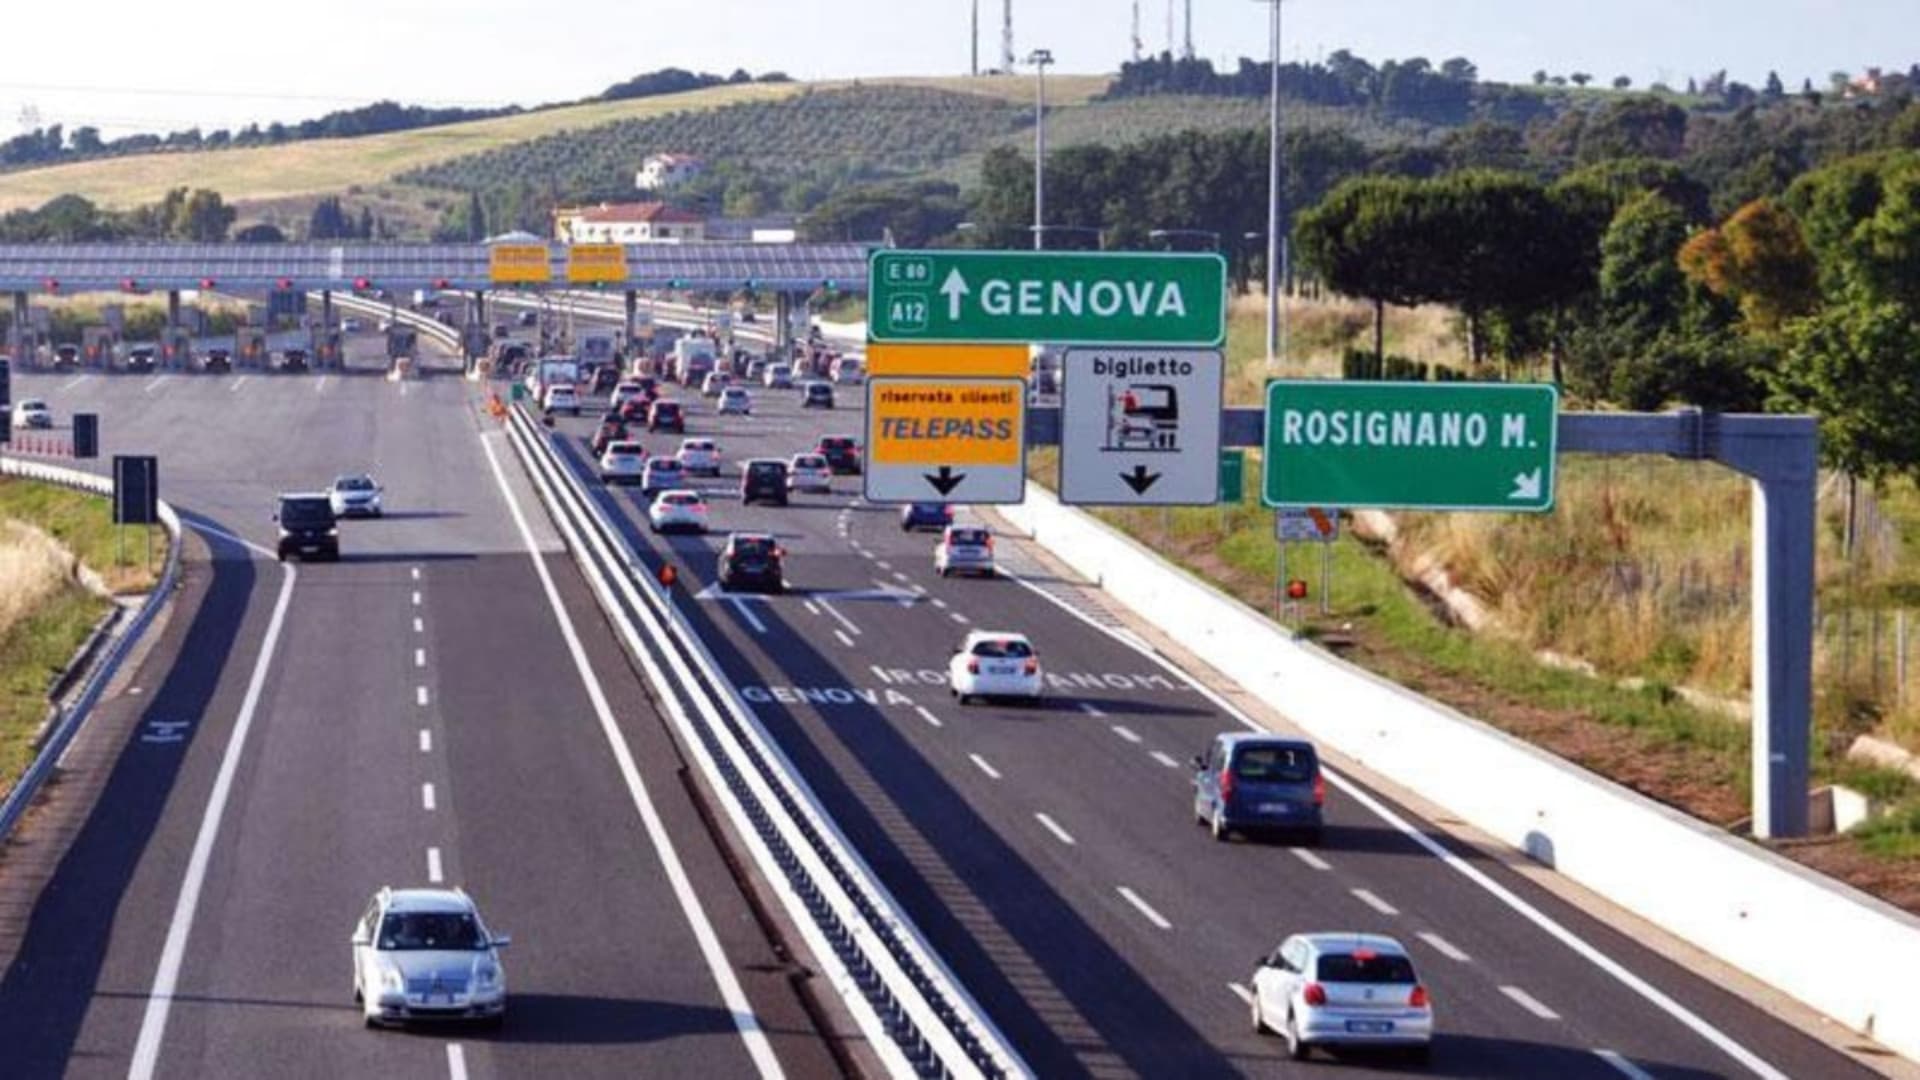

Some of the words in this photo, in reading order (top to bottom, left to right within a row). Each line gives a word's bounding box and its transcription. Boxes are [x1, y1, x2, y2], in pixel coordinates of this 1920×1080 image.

[889, 263, 900, 279] E
[905, 263, 926, 279] 80
[980, 278, 1187, 317] GENOVA
[891, 302, 924, 321] A12
[1093, 357, 1192, 378] biglietto
[880, 390, 952, 403] riservata
[960, 390, 1013, 403] clienti
[880, 417, 1012, 440] TELEPASS
[1283, 409, 1487, 446] ROSIGNANO
[1501, 413, 1538, 448] M.
[888, 669, 1135, 690] ROANO
[740, 686, 914, 705] GENOVA
